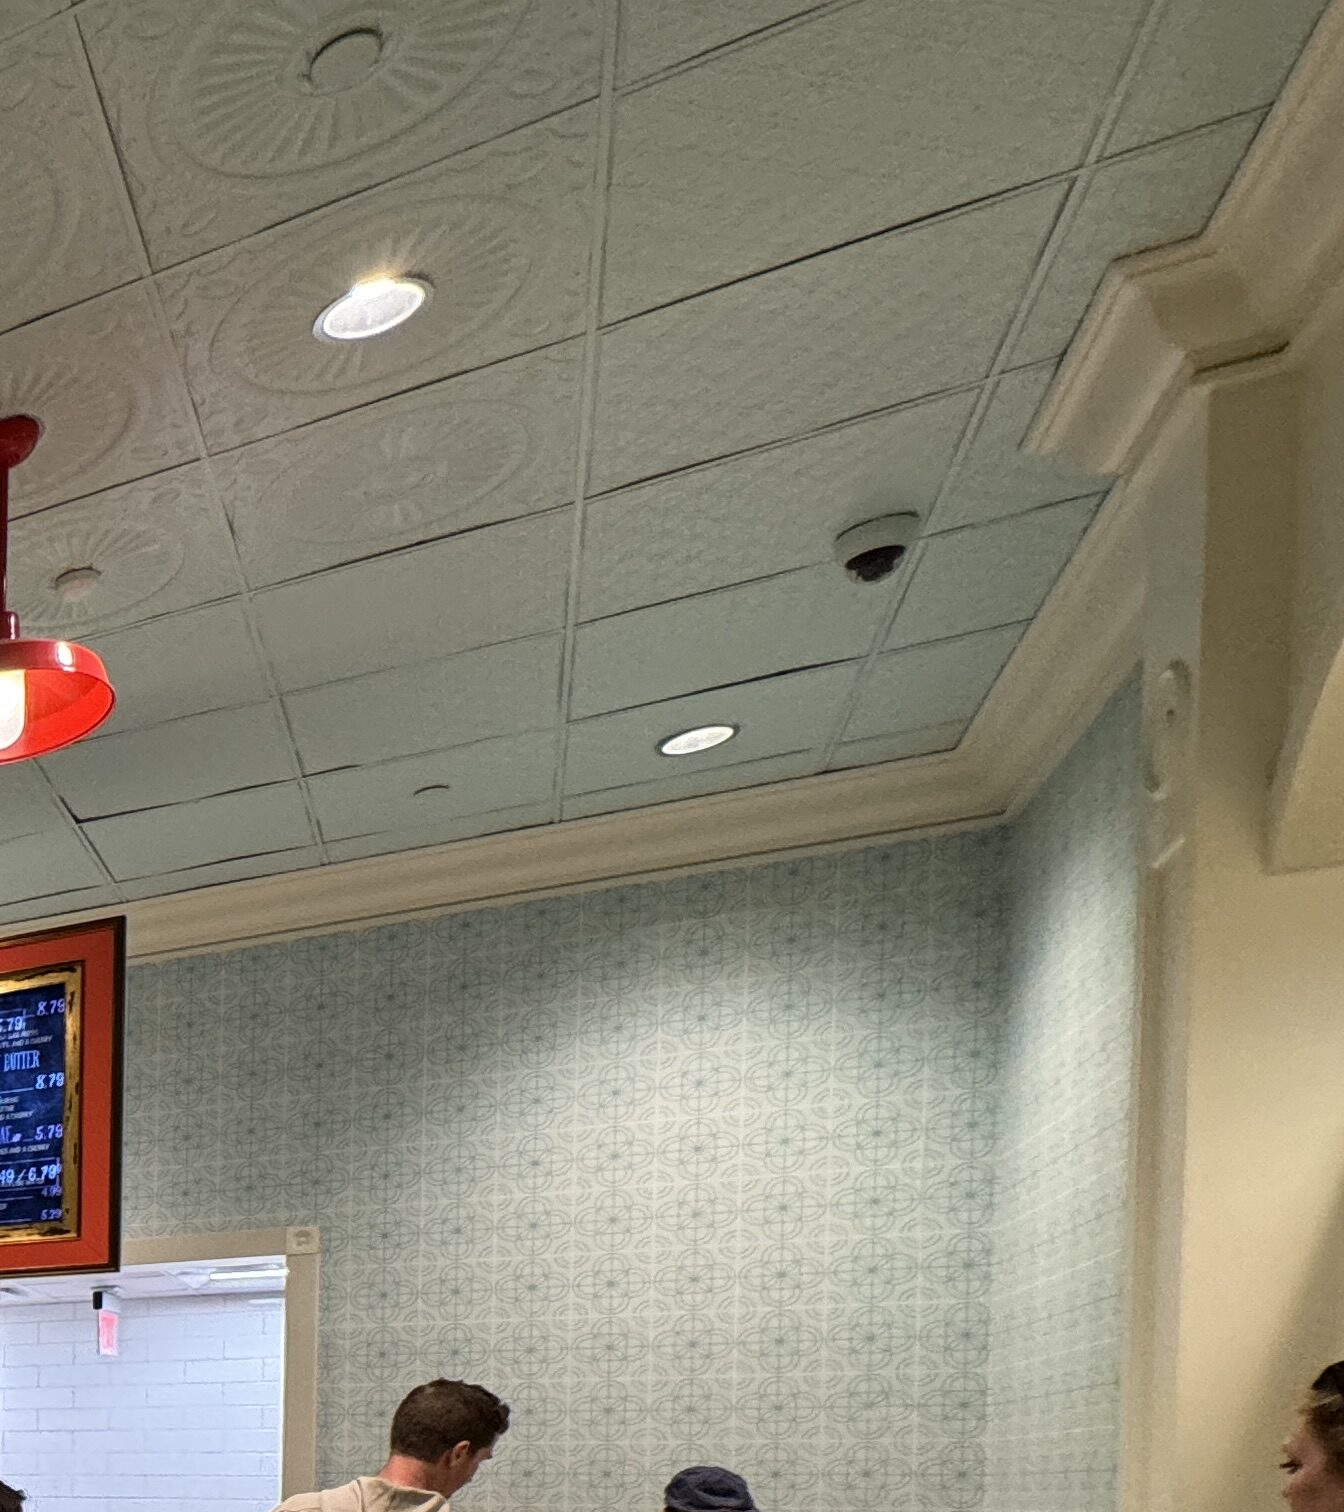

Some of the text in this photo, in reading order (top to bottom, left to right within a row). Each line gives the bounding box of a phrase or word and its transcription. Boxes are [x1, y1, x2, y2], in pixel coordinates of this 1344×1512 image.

[3, 1050, 41, 1073] BUTTER
[35, 1072, 65, 1090] 8.79
[35, 1124, 63, 1141] 5.79
